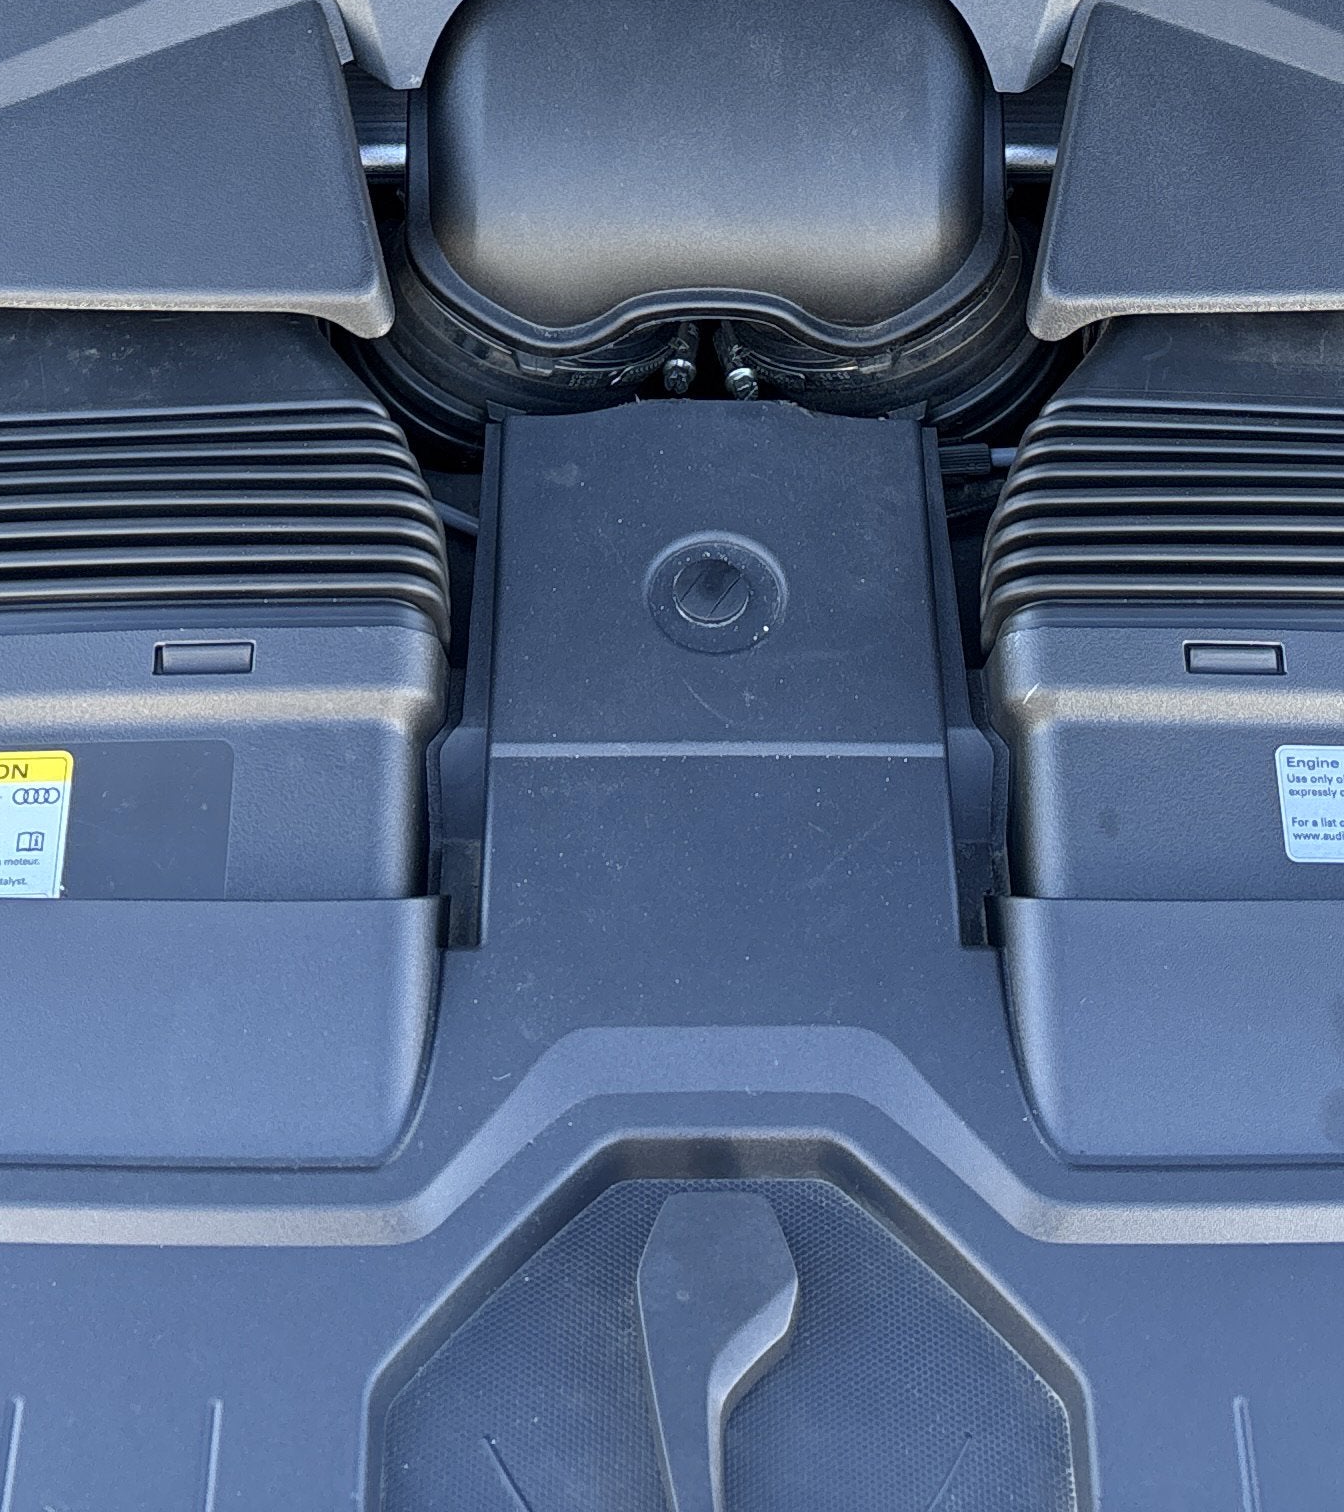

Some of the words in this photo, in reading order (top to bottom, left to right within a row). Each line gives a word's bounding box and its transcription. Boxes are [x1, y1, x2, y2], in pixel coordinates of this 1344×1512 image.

[1286, 756, 1340, 771] Engine
[1286, 774, 1307, 783] Use
[1310, 774, 1333, 785] only
[1288, 788, 1337, 799] expressly
[1291, 817, 1309, 827] For
[1311, 819, 1319, 827] a
[1321, 817, 1338, 828] list
[3, 857, 40, 866] moteur.
